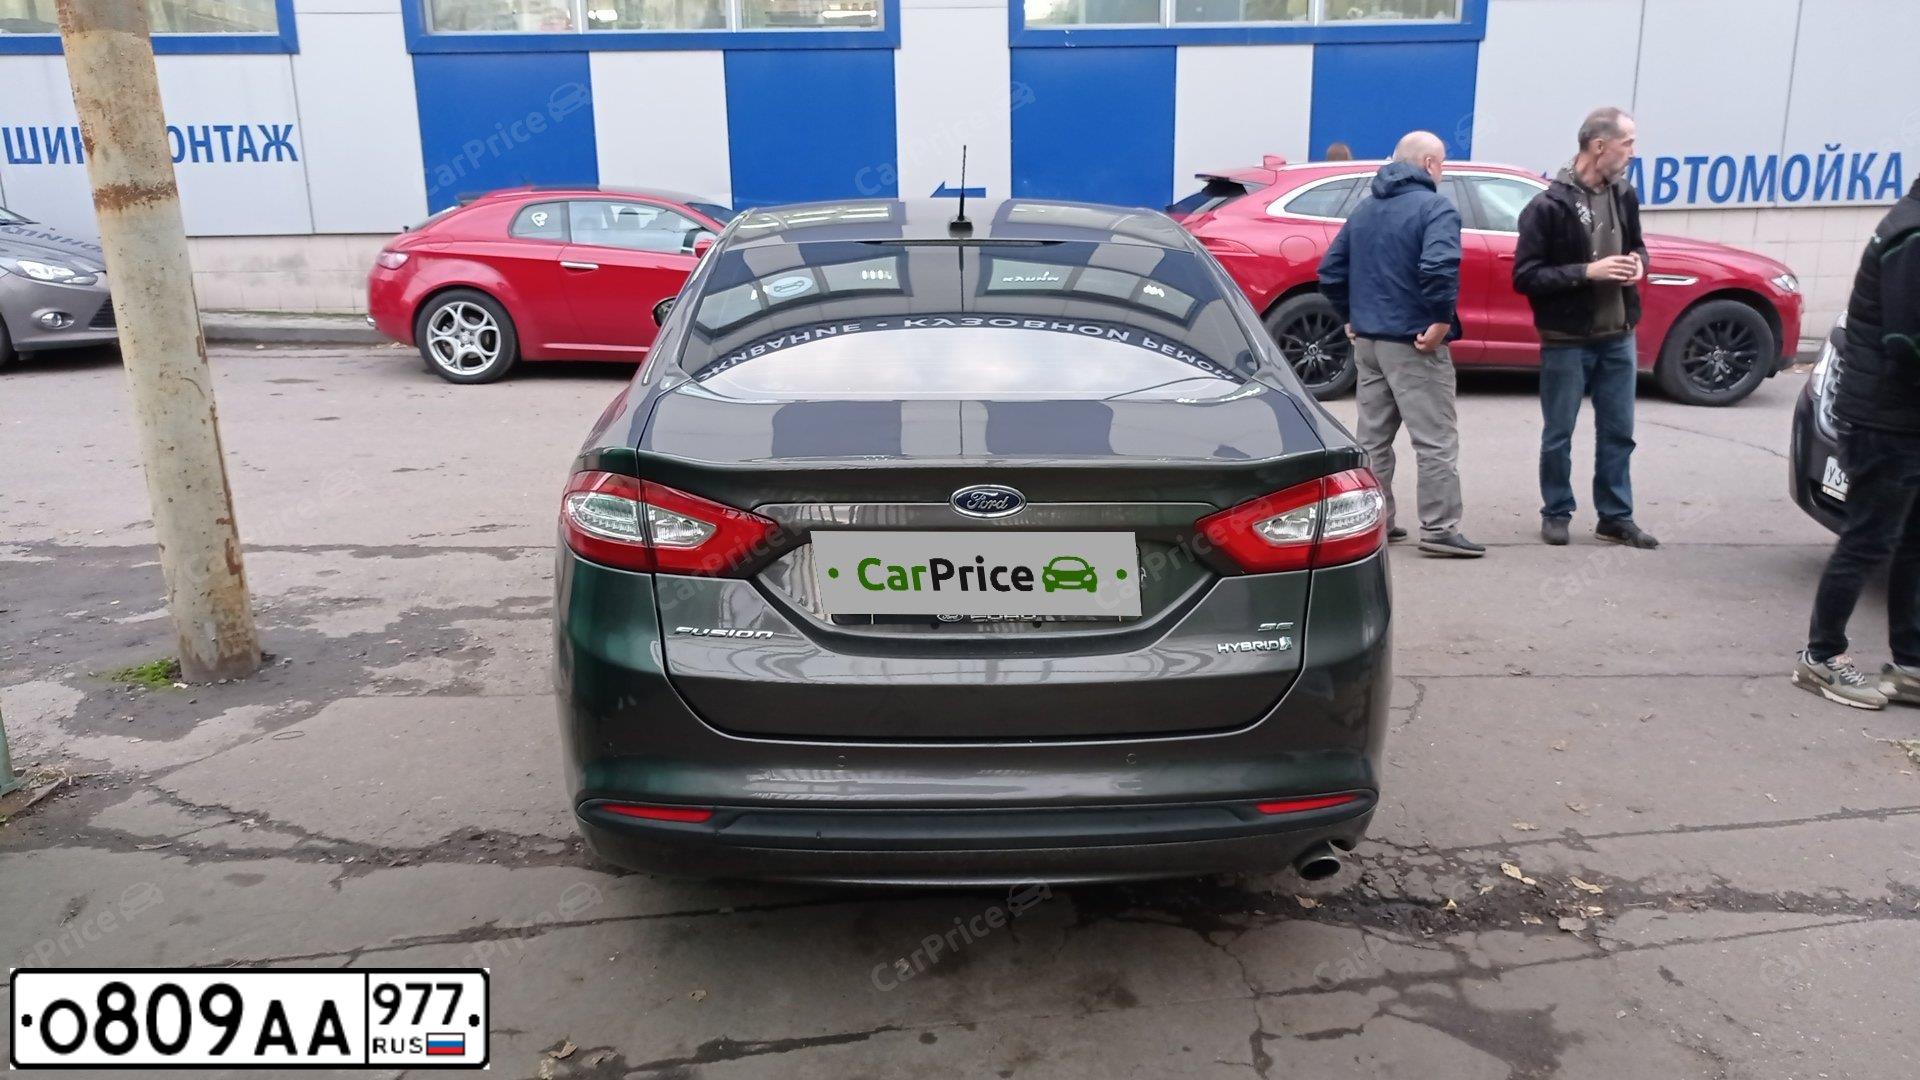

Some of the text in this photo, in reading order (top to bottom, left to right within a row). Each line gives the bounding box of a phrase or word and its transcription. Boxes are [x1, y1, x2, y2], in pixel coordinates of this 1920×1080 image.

[1627, 143, 1904, 205] АВТОМОЙКА
[966, 491, 1010, 510] Ford
[1217, 640, 1279, 653] HYBRID
